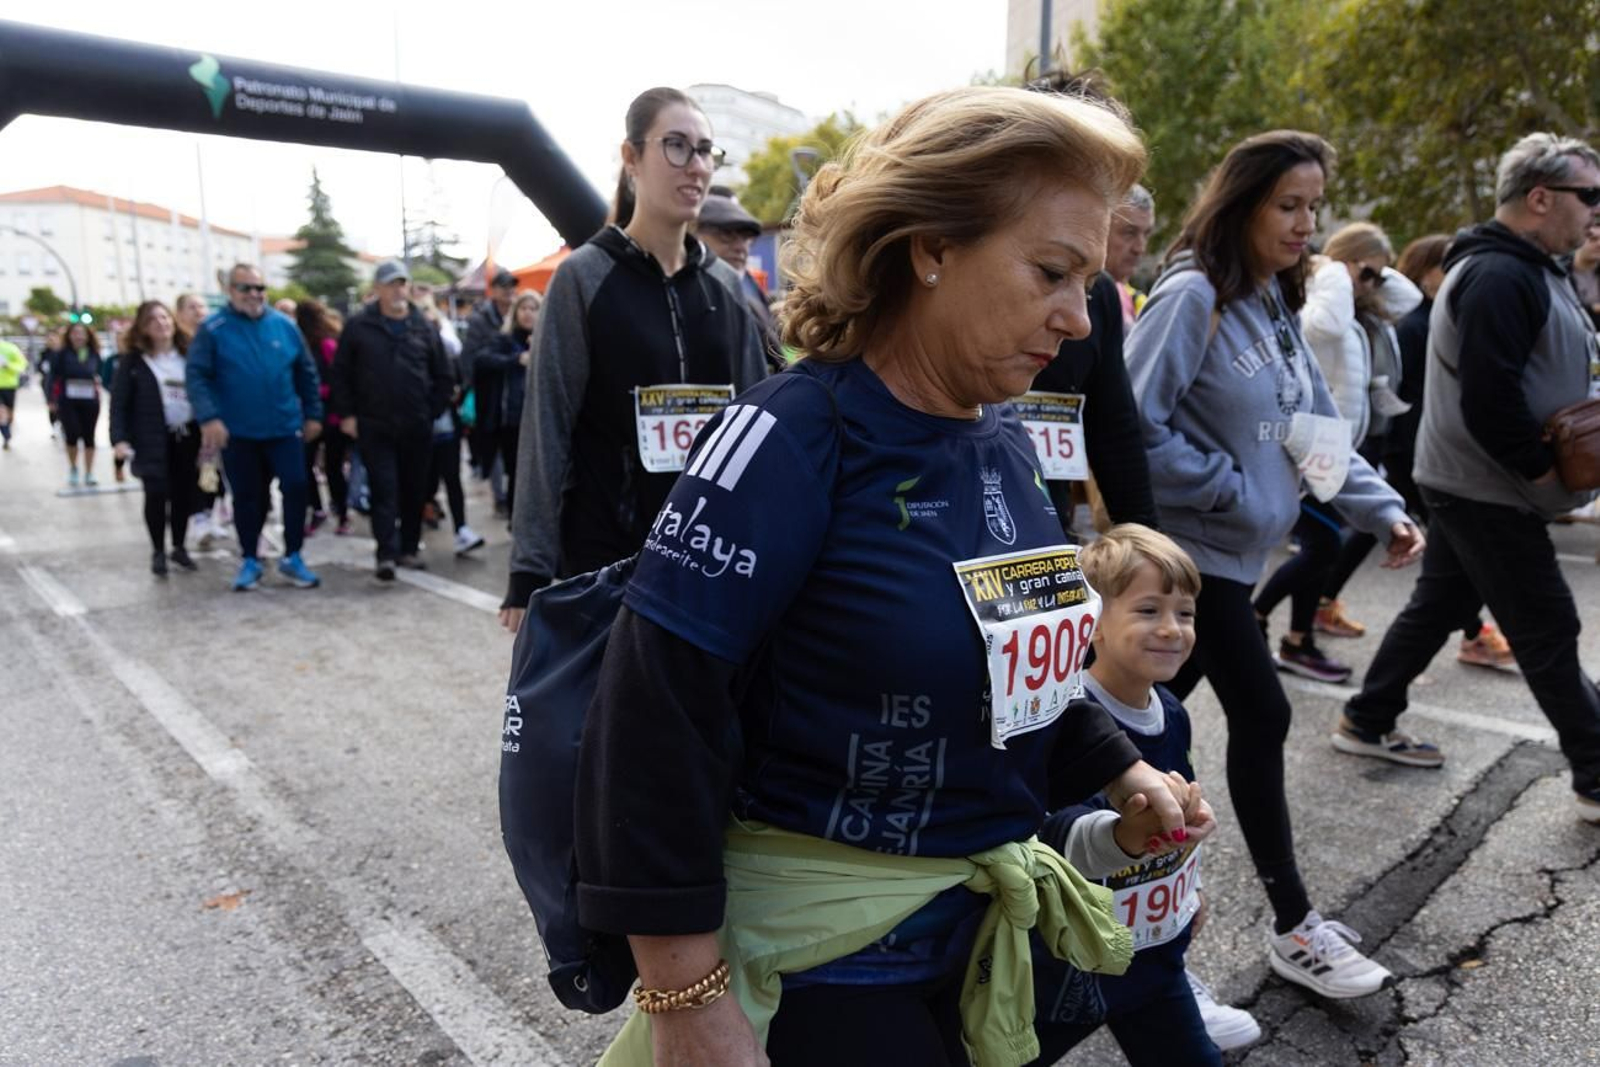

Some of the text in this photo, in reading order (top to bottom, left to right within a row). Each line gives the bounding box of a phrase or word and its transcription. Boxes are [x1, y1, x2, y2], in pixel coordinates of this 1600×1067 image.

[233, 76, 397, 113] Patronato Municipal de
[235, 93, 363, 123] Deportes de Jaén
[652, 497, 757, 578] talaya
[966, 567, 1005, 602] XXV
[1002, 561, 1054, 580] CARRERA
[1020, 575, 1051, 595] gran
[1013, 600, 1024, 614] LA
[1002, 612, 1095, 696] 1908
[880, 692, 931, 729] IES
